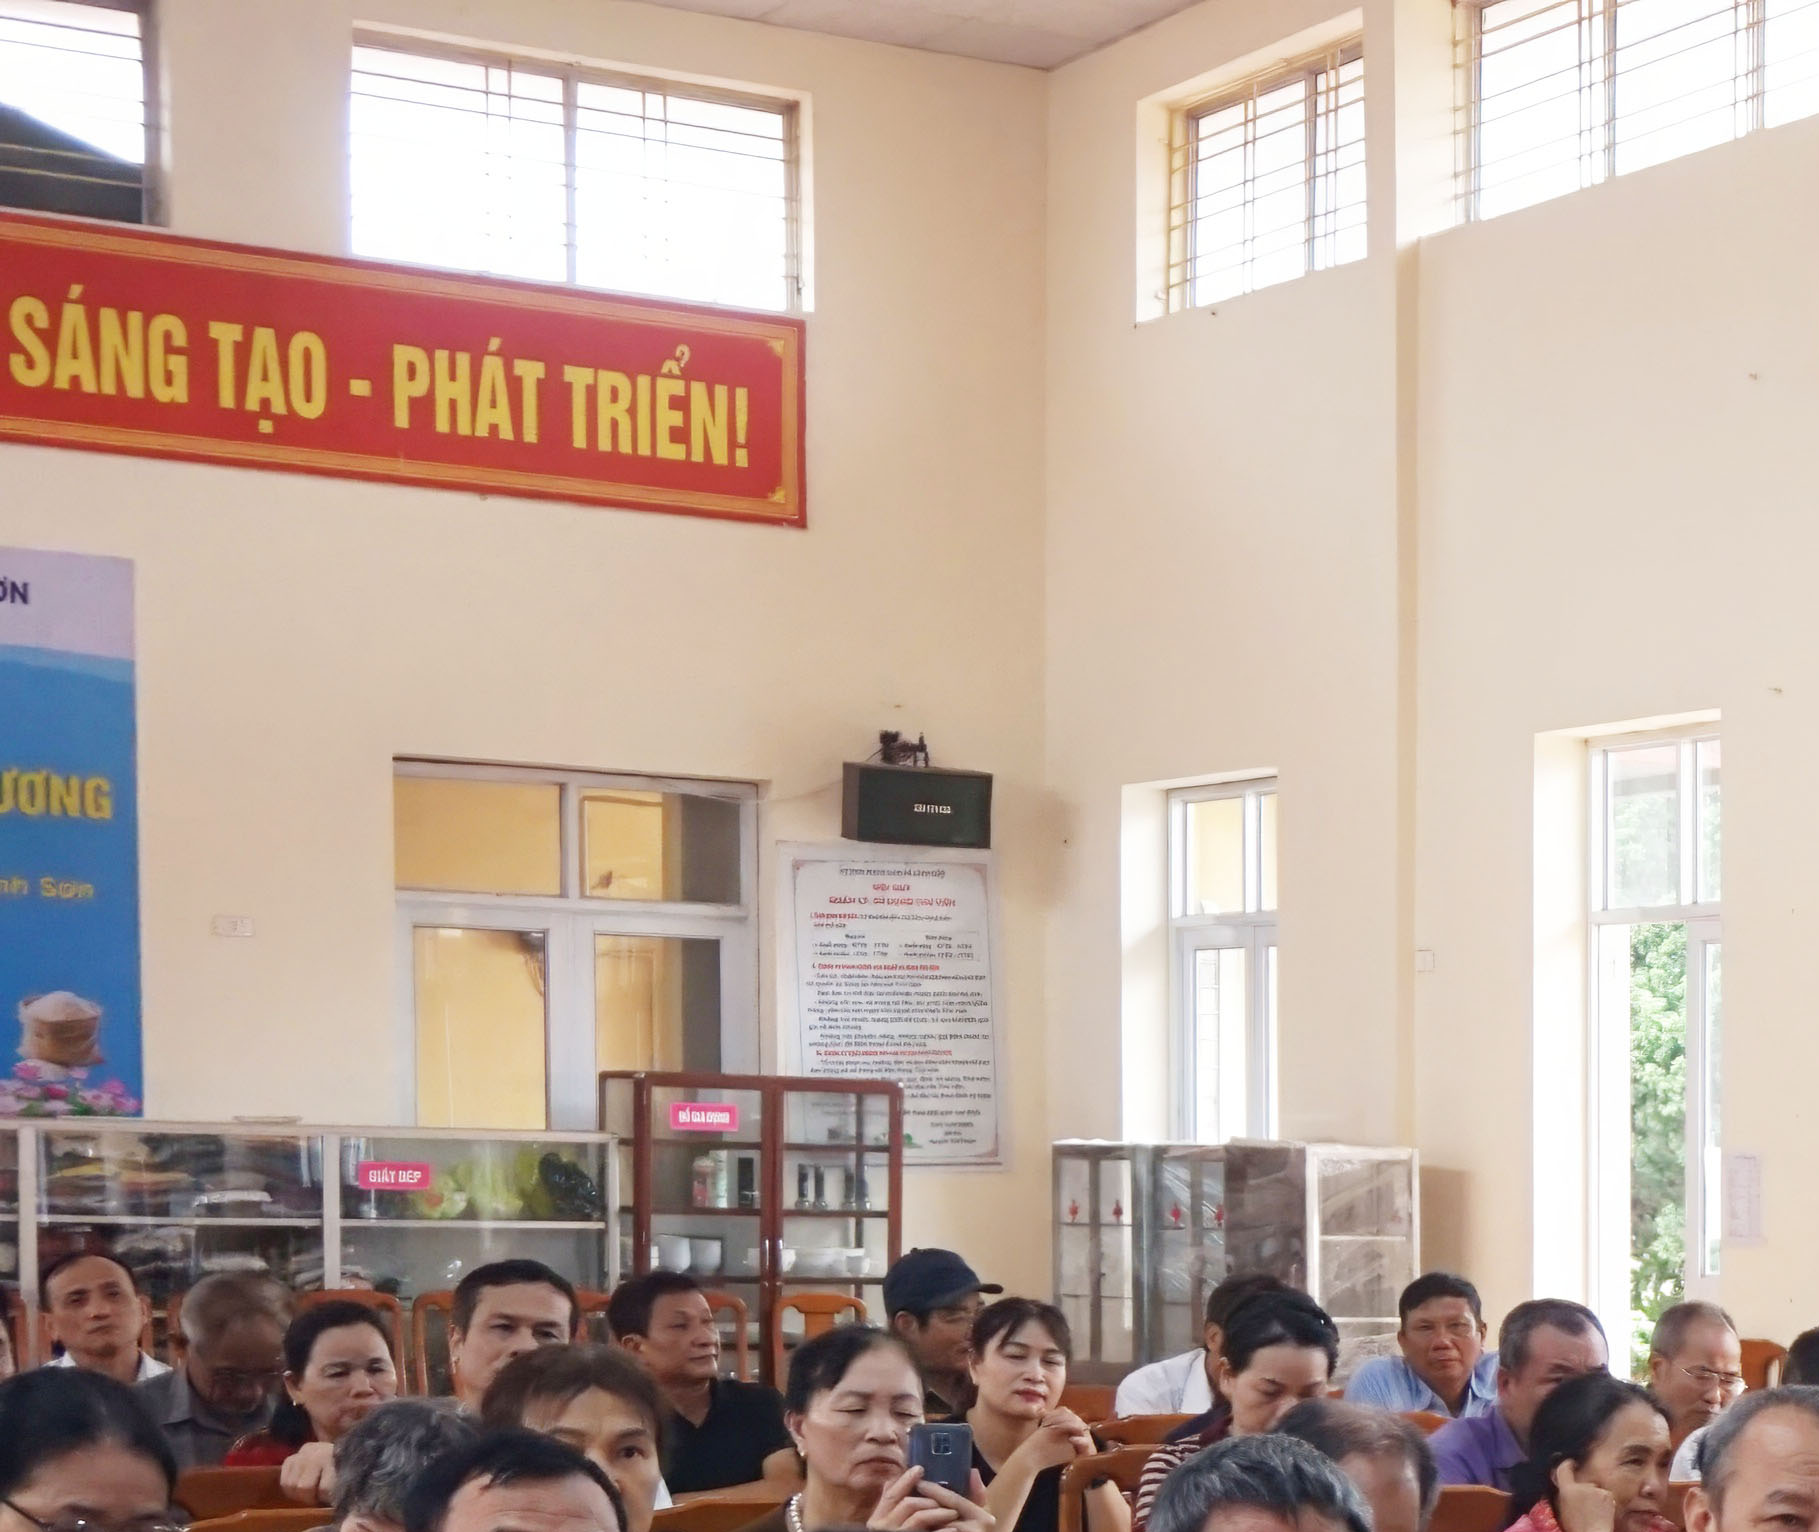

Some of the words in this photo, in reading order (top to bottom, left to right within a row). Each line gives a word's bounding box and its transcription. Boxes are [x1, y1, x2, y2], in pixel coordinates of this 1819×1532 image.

[9, 284, 189, 404] SÁNG
[209, 321, 327, 434] TẠO
[349, 377, 372, 396] -
[393, 337, 546, 444] PHÁT
[562, 343, 750, 468] TRIỂN!
